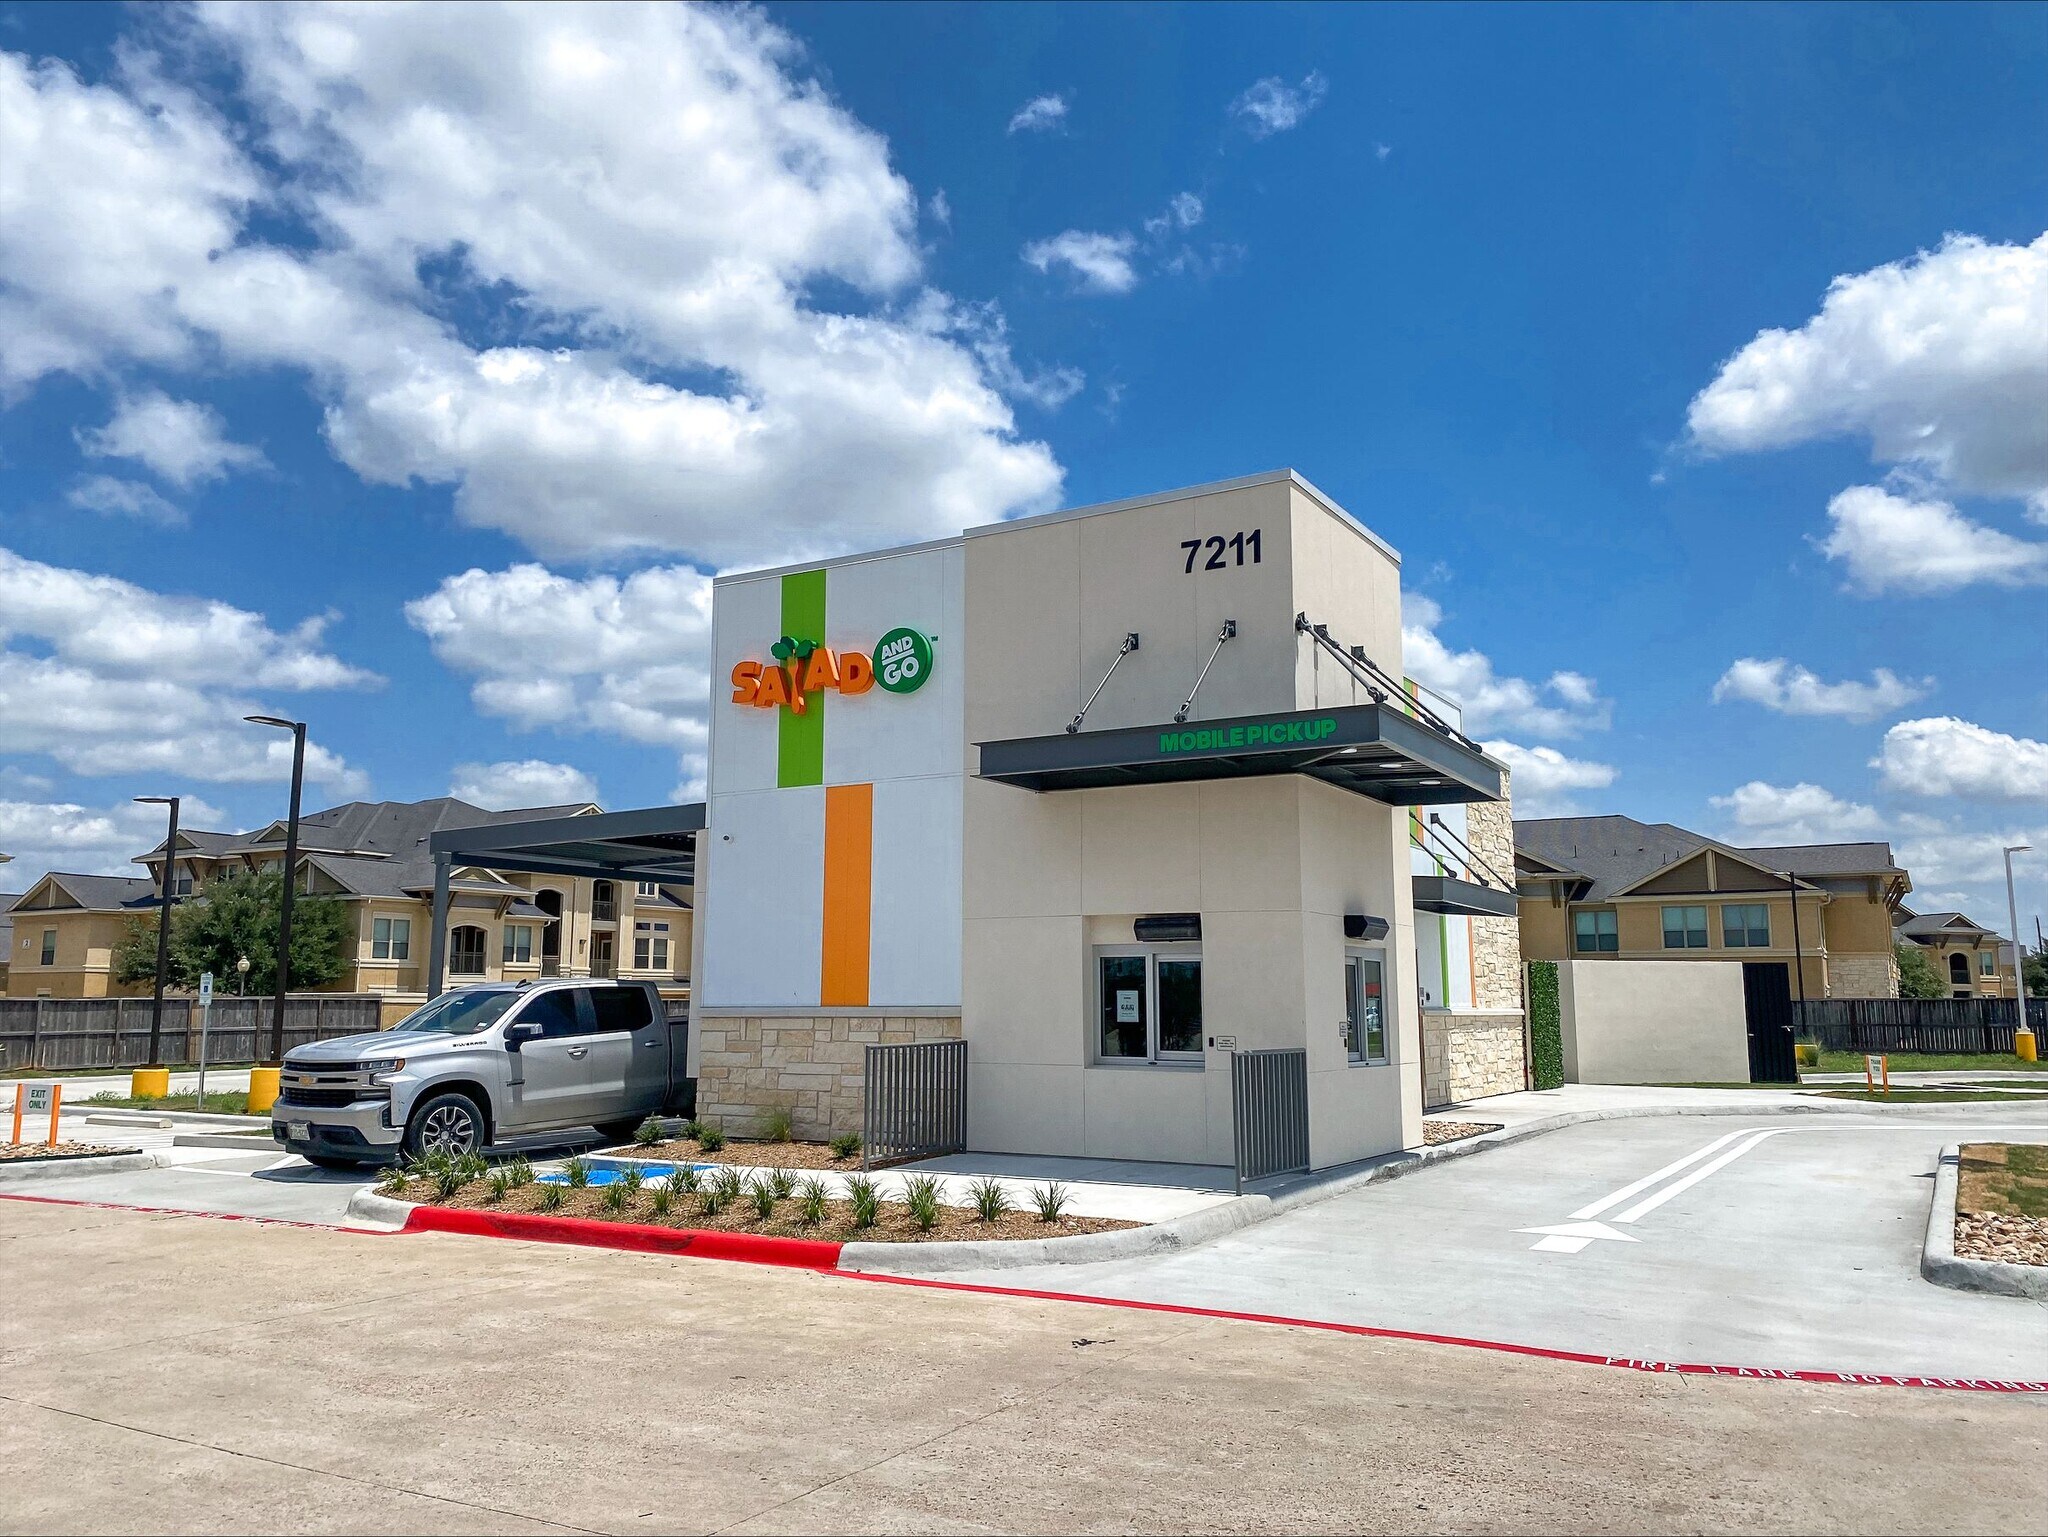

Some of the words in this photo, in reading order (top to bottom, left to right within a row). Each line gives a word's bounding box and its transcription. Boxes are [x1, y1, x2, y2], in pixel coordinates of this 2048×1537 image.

[1180, 528, 1262, 575] 7211
[881, 636, 914, 660] AND
[731, 647, 876, 714] SALAD
[883, 657, 920, 686] GO
[1159, 726, 1244, 753] MOBILE
[28, 1100, 47, 1109] ONLY
[30, 1089, 46, 1098] EXIT
[1605, 1356, 1681, 1372] FIRE
[1710, 1365, 1802, 1379] LANE
[1836, 1373, 1882, 1384] NO
[1890, 1376, 2046, 1391] PARKING
